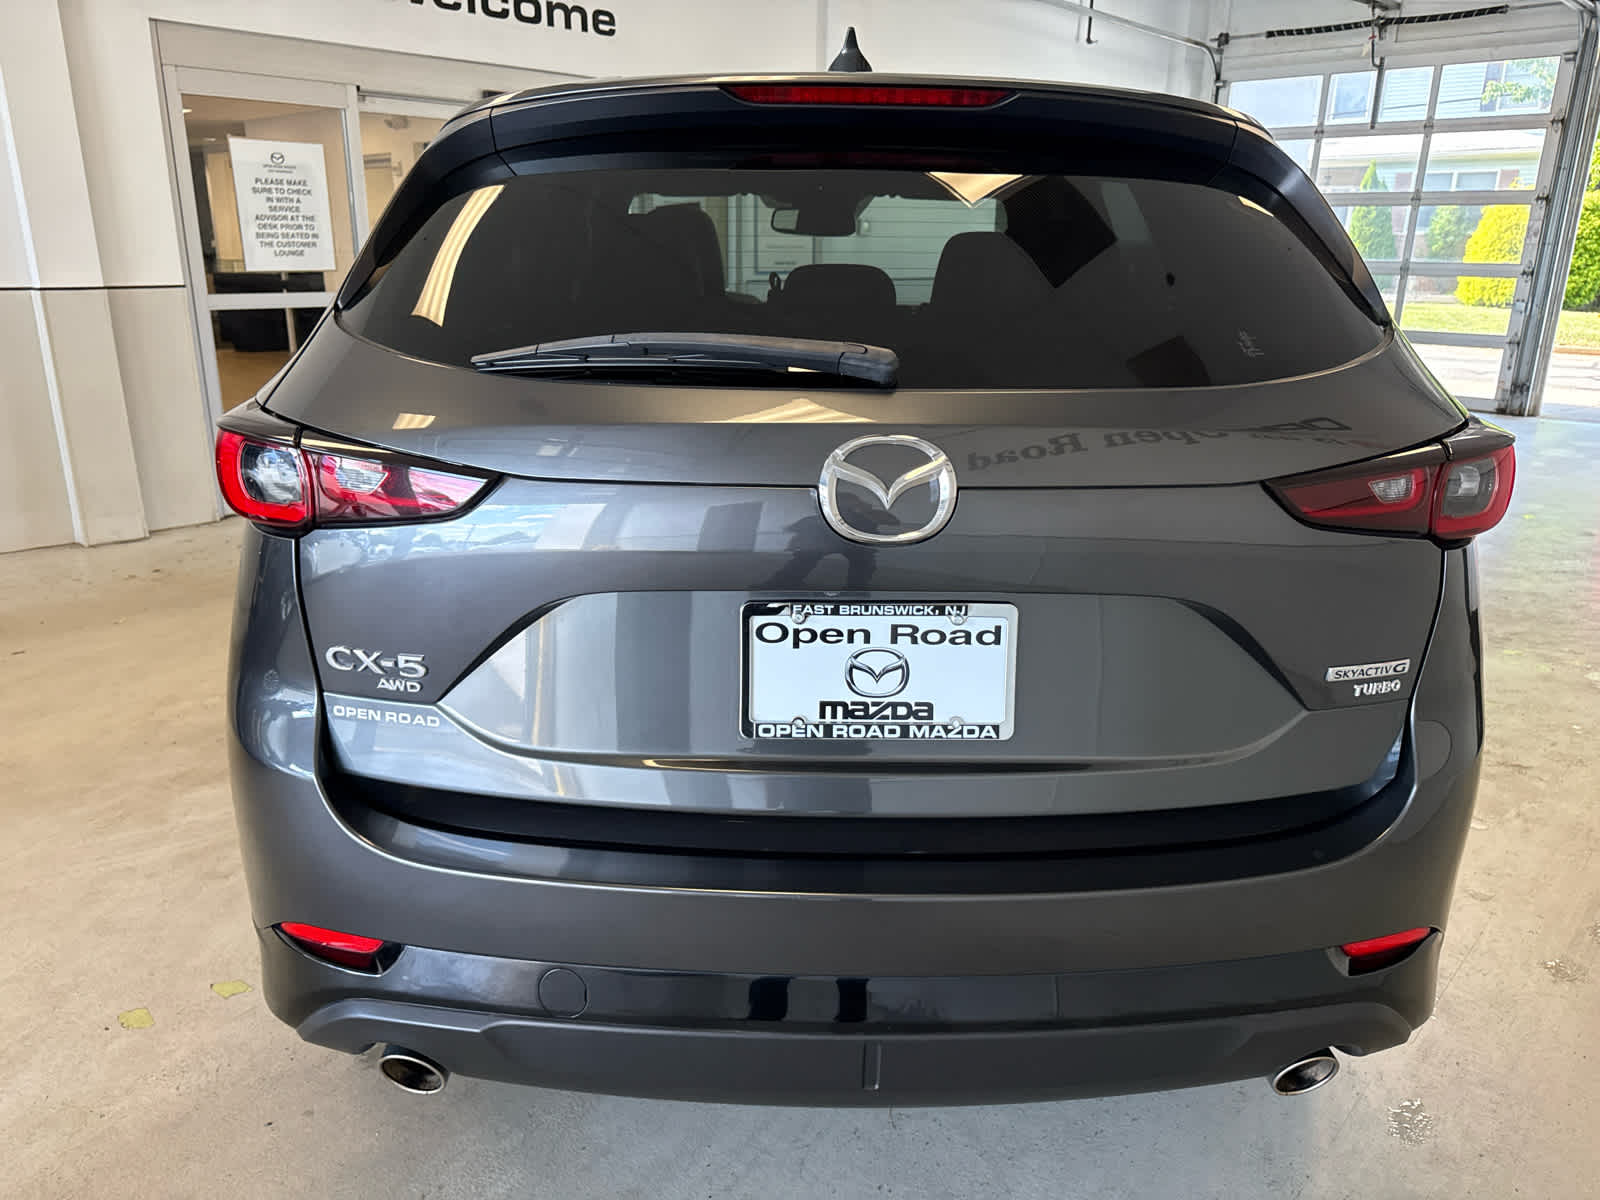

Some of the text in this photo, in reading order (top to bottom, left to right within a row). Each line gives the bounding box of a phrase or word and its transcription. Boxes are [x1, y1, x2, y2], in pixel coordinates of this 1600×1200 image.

[410, 0, 616, 37] come
[255, 177, 284, 186] PLEASE
[275, 187, 285, 195] TO
[287, 188, 312, 196] CHECK
[839, 605, 939, 615] BRUNSWICK,
[756, 621, 1001, 648] Open Road
[325, 645, 428, 679] CX-5
[376, 678, 422, 693] AWD
[1353, 679, 1401, 697] TURBO
[332, 705, 441, 727] OPEN ROAD
[757, 724, 998, 739] OPEN ROAD MAZDA
